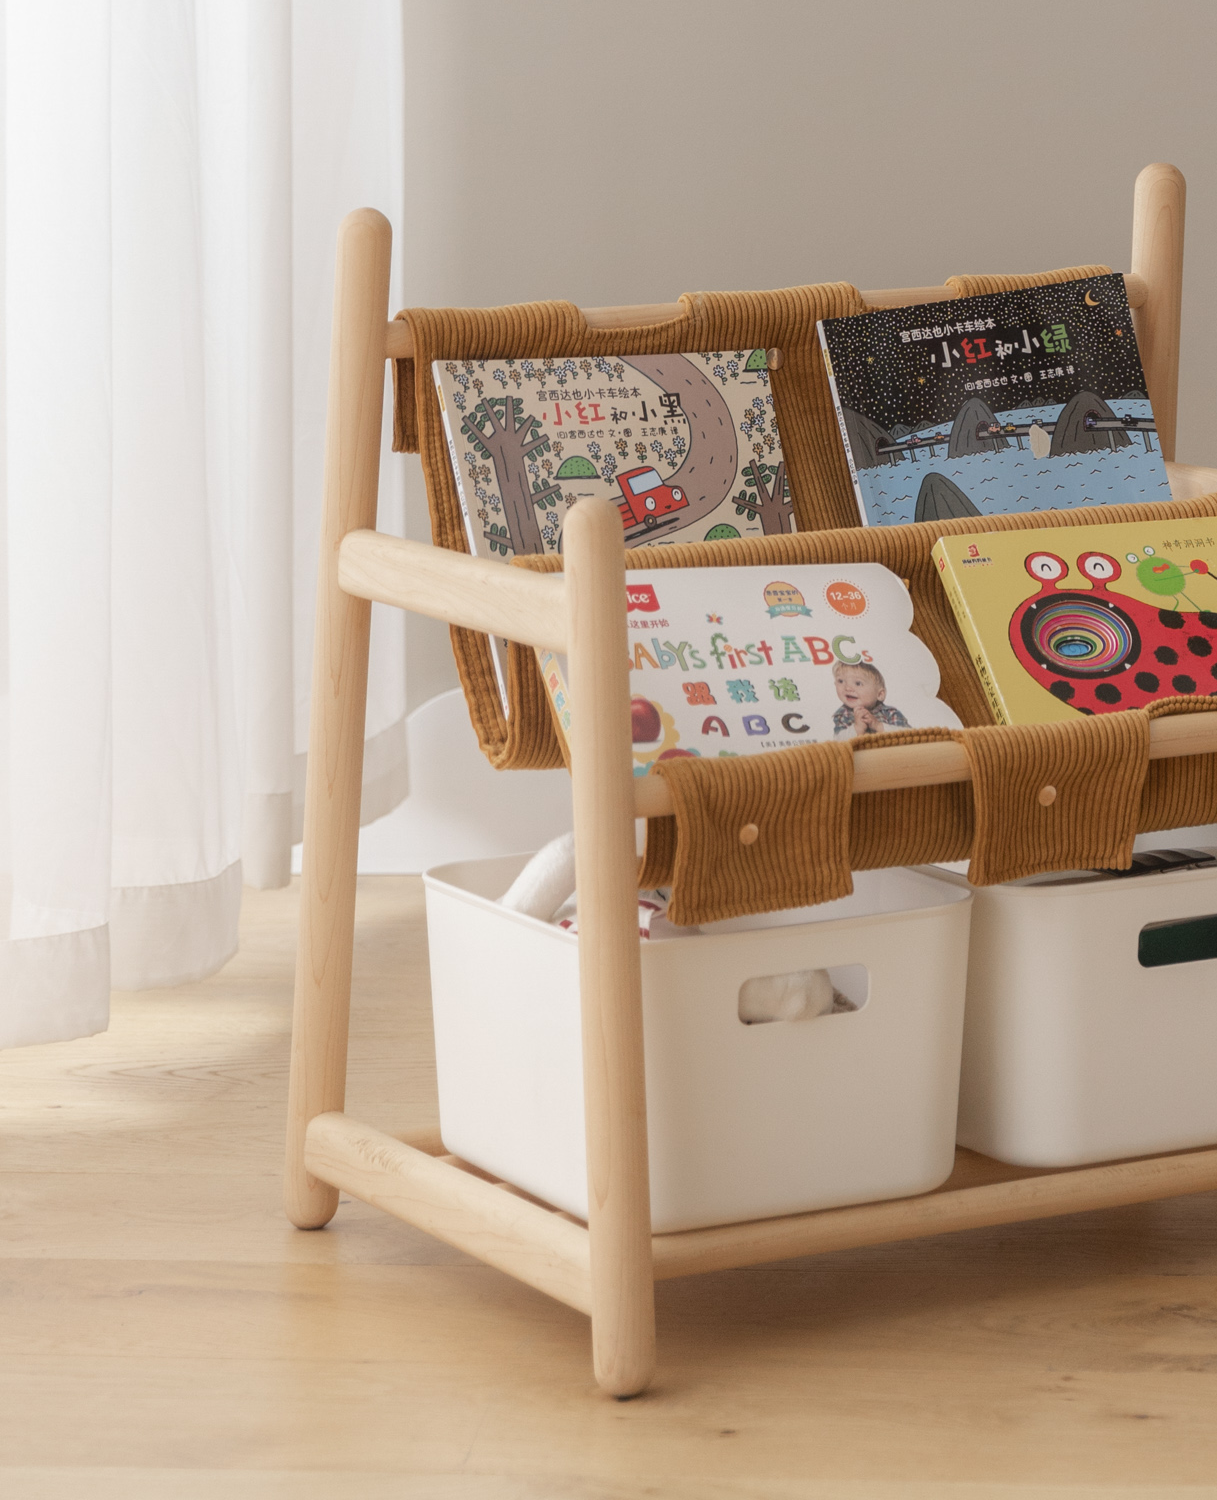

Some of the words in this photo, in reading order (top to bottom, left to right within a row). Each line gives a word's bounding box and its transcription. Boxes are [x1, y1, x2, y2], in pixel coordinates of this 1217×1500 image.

[899, 317, 997, 343] 宫西达也小卡车绘本
[930, 323, 1073, 368] 小红和小绿
[536, 386, 642, 402] 宫西达也小卡车绘本
[542, 392, 687, 426] 小红和小黑
[1162, 537, 1215, 552] 神奇洞洞书
[830, 591, 861, 601] 12-36
[841, 602, 857, 610] 个月
[627, 618, 670, 630] 这里开始
[629, 637, 708, 672] AbY's
[710, 632, 774, 670] first
[682, 677, 801, 706] 跟我读
